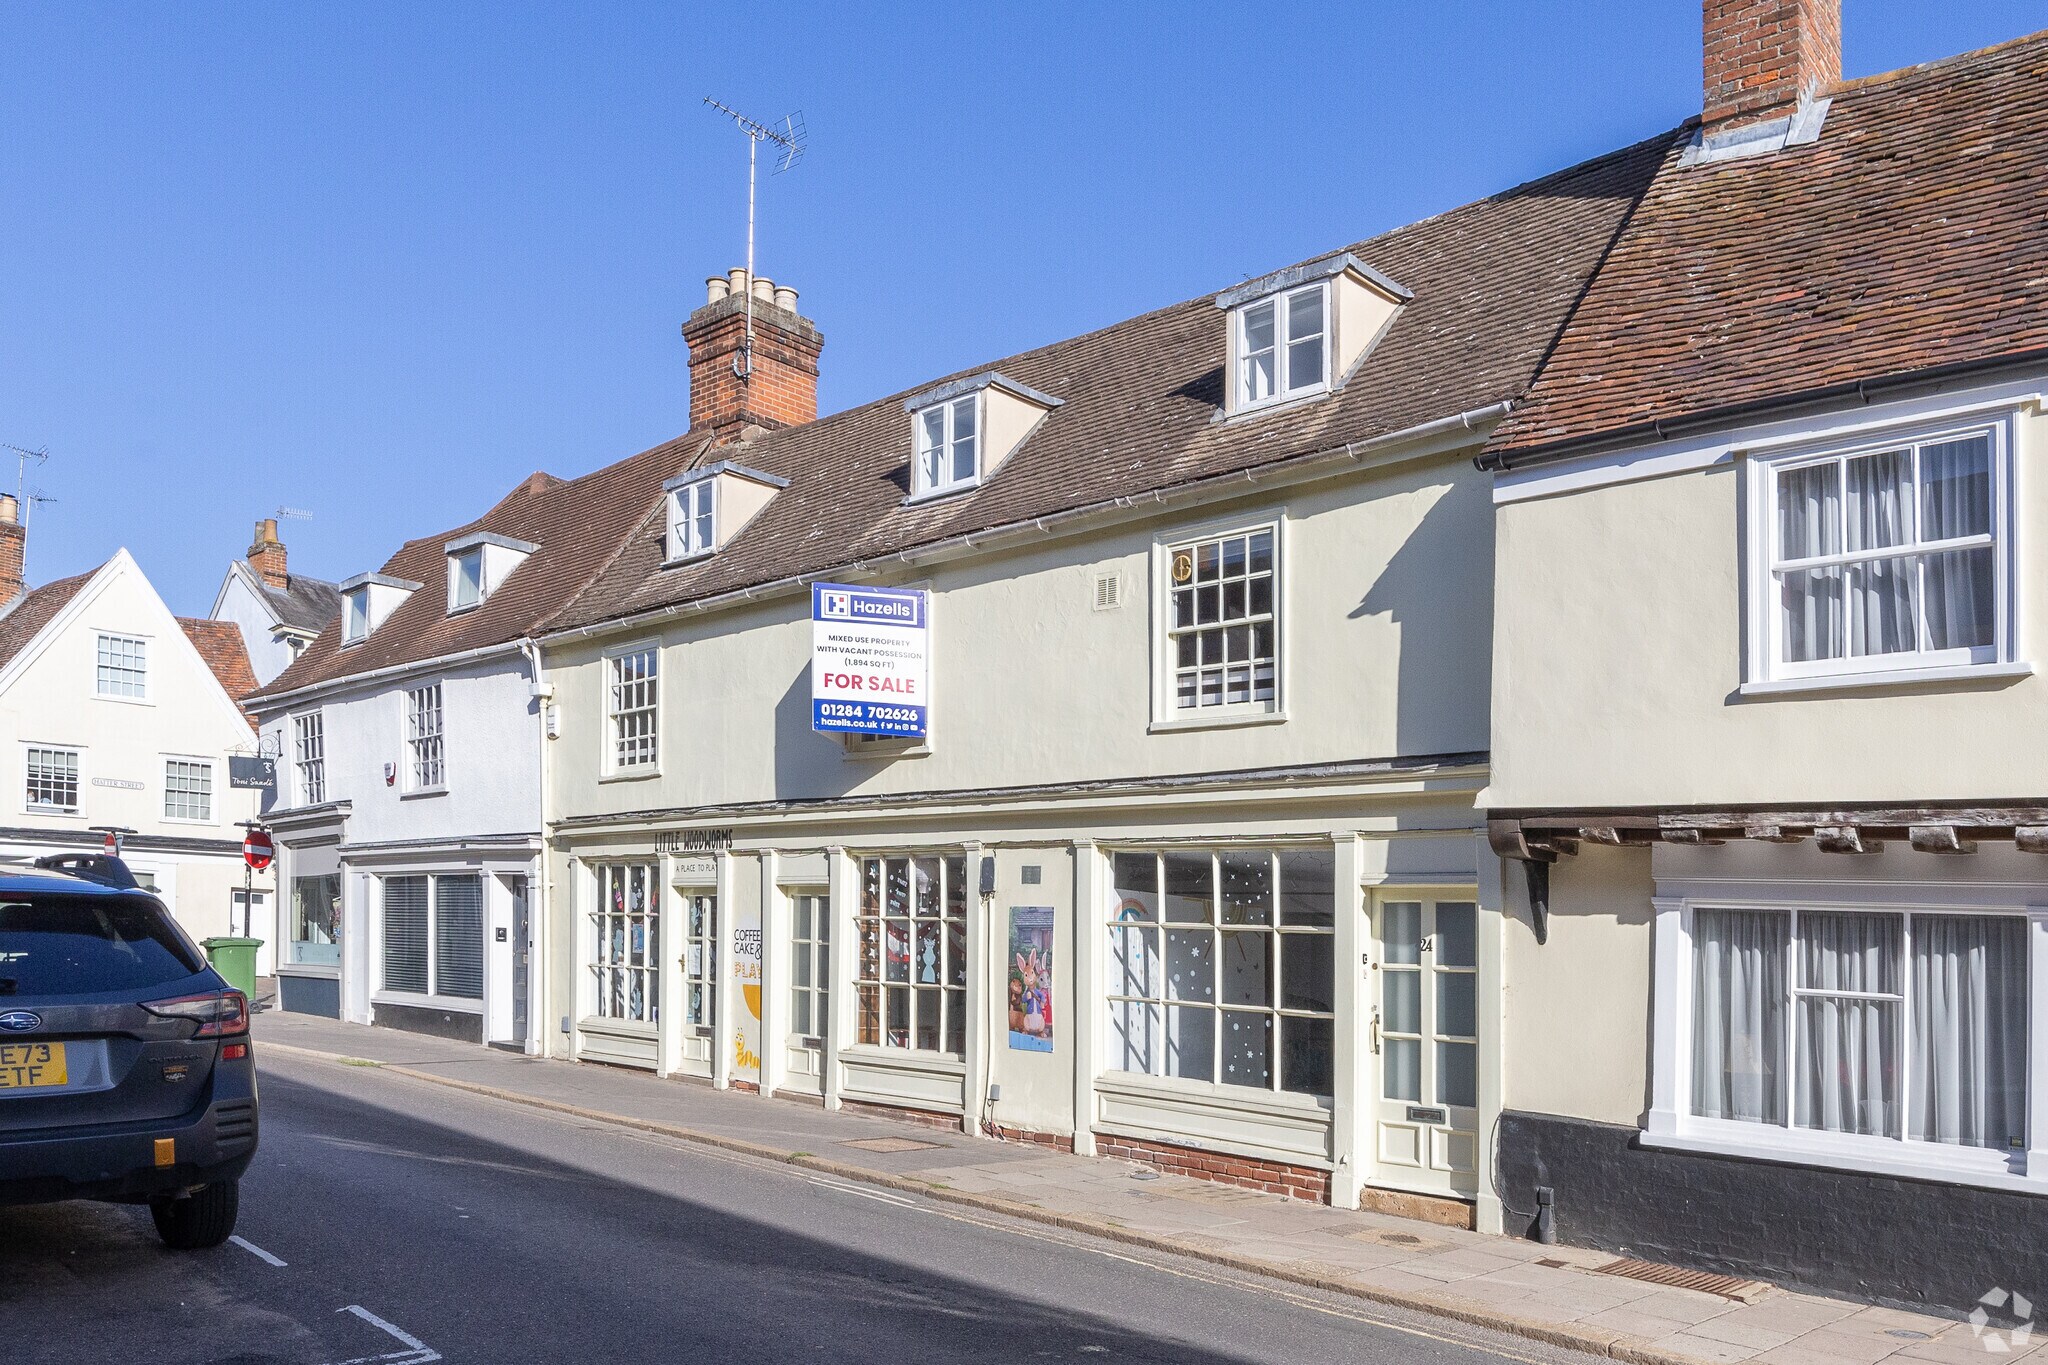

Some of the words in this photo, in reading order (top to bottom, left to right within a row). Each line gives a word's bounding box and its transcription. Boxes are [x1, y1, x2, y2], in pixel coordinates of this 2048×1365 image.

[853, 600, 911, 617] Hazells
[828, 635, 854, 643] MIXED
[870, 638, 910, 647] PROPERTY
[817, 645, 838, 653] WITH
[839, 647, 872, 655] VACANT
[874, 649, 922, 659] POSSESSION
[869, 660, 881, 668] SQ
[882, 661, 895, 670] FT)
[824, 672, 863, 690] FOR
[868, 676, 915, 694] SALE
[821, 703, 863, 717] 01284
[867, 706, 918, 721] 702626
[821, 717, 878, 729] hazells.co.uk
[93, 778, 118, 787] HATTER
[119, 781, 142, 789] STREET
[232, 776, 248, 785] Toni
[654, 831, 680, 852] LITTLE
[683, 828, 733, 850] WOODWORMS
[675, 865, 680, 873] A
[680, 864, 696, 873] PLACE
[697, 864, 704, 872] TO
[733, 928, 761, 941] COFFEE
[733, 942, 755, 955] CAKE
[754, 943, 762, 960] &
[1420, 938, 1433, 952] 24
[1, 1044, 51, 1065] E73
